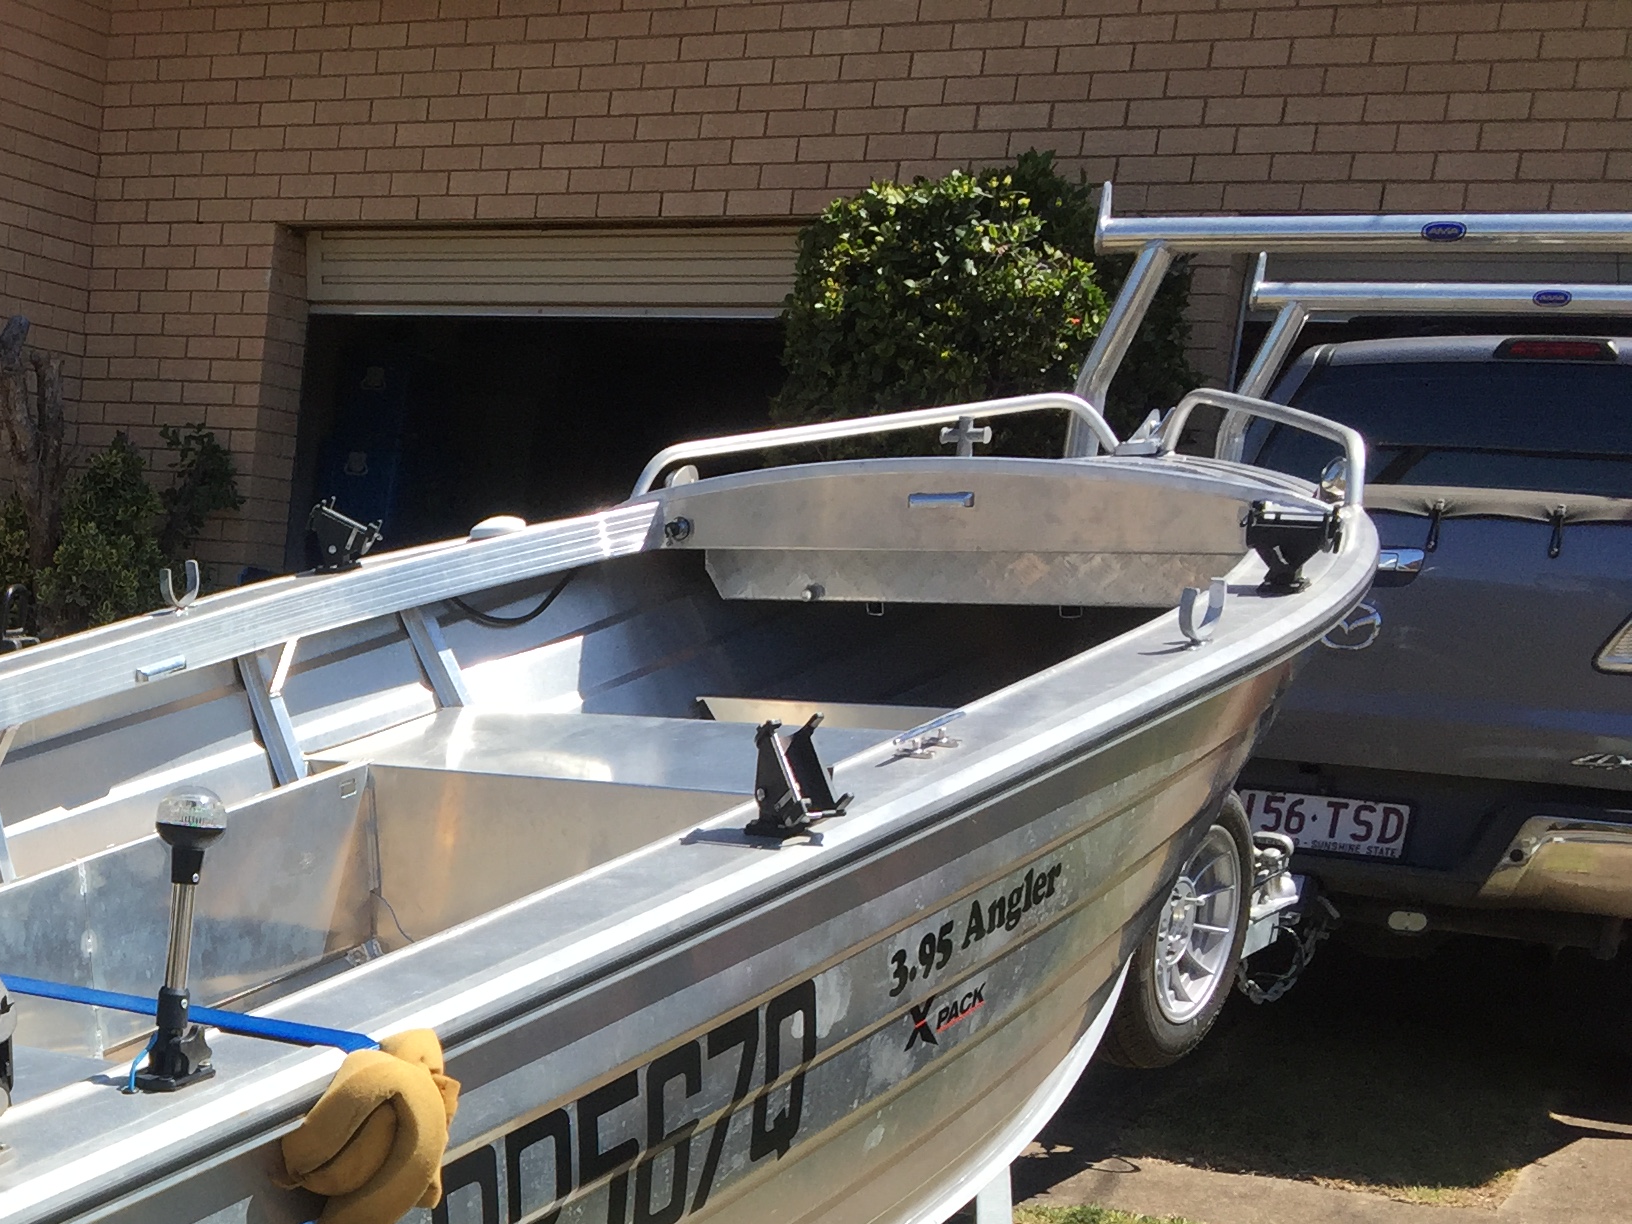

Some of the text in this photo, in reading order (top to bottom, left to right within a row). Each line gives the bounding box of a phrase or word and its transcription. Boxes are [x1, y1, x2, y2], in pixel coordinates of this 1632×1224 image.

[1311, 840, 1362, 853] SUNSHINE
[1366, 845, 1398, 858] STATE
[889, 862, 1062, 997] 3.95 Angler
[904, 982, 986, 1052] X PACK
